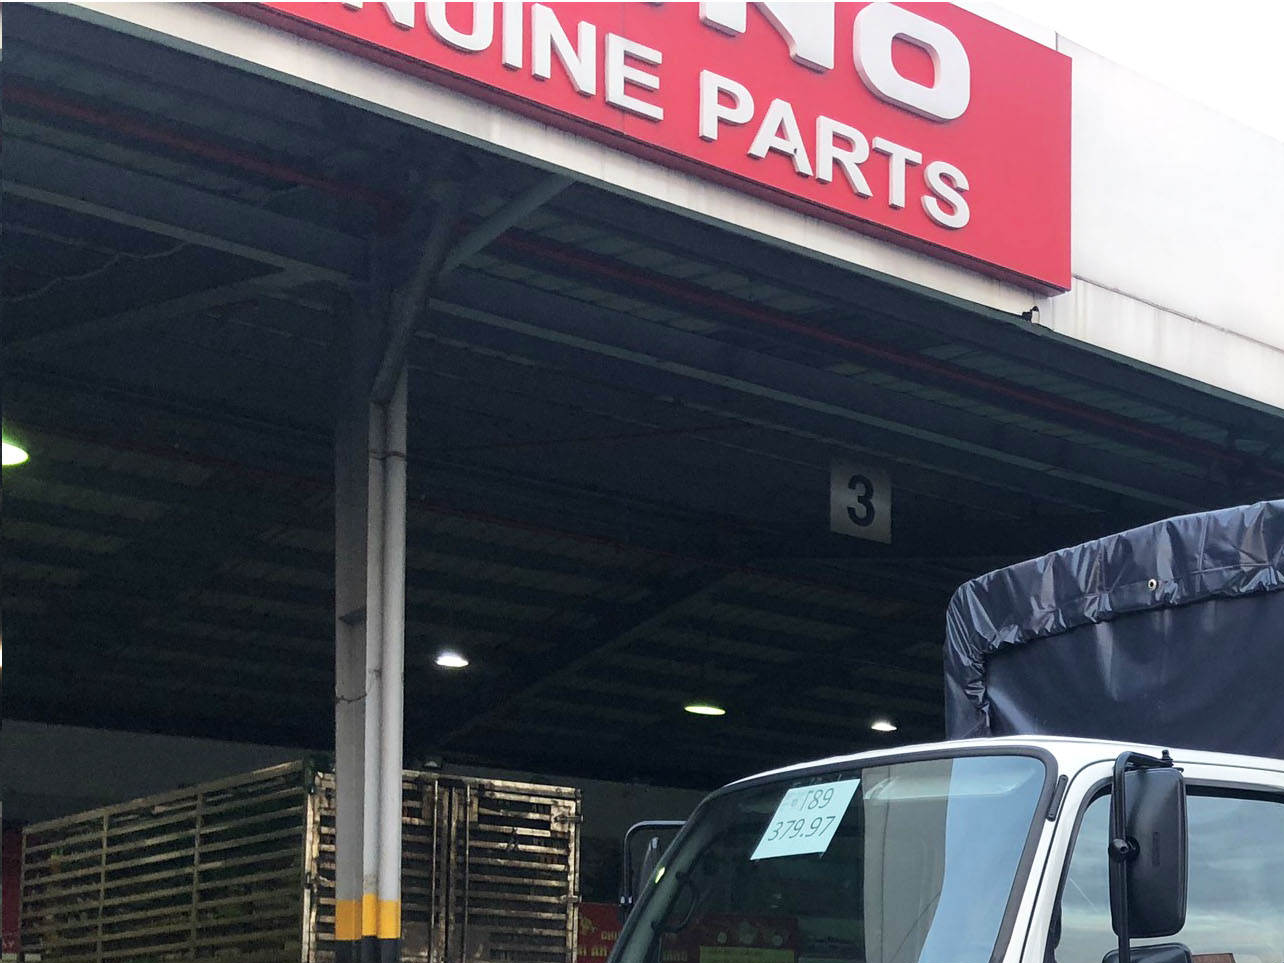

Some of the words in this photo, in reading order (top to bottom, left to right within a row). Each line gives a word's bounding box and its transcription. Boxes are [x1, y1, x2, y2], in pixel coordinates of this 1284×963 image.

[698, 69, 971, 230] PARTS
[847, 474, 875, 527] 3
[767, 815, 836, 842] 379.97
